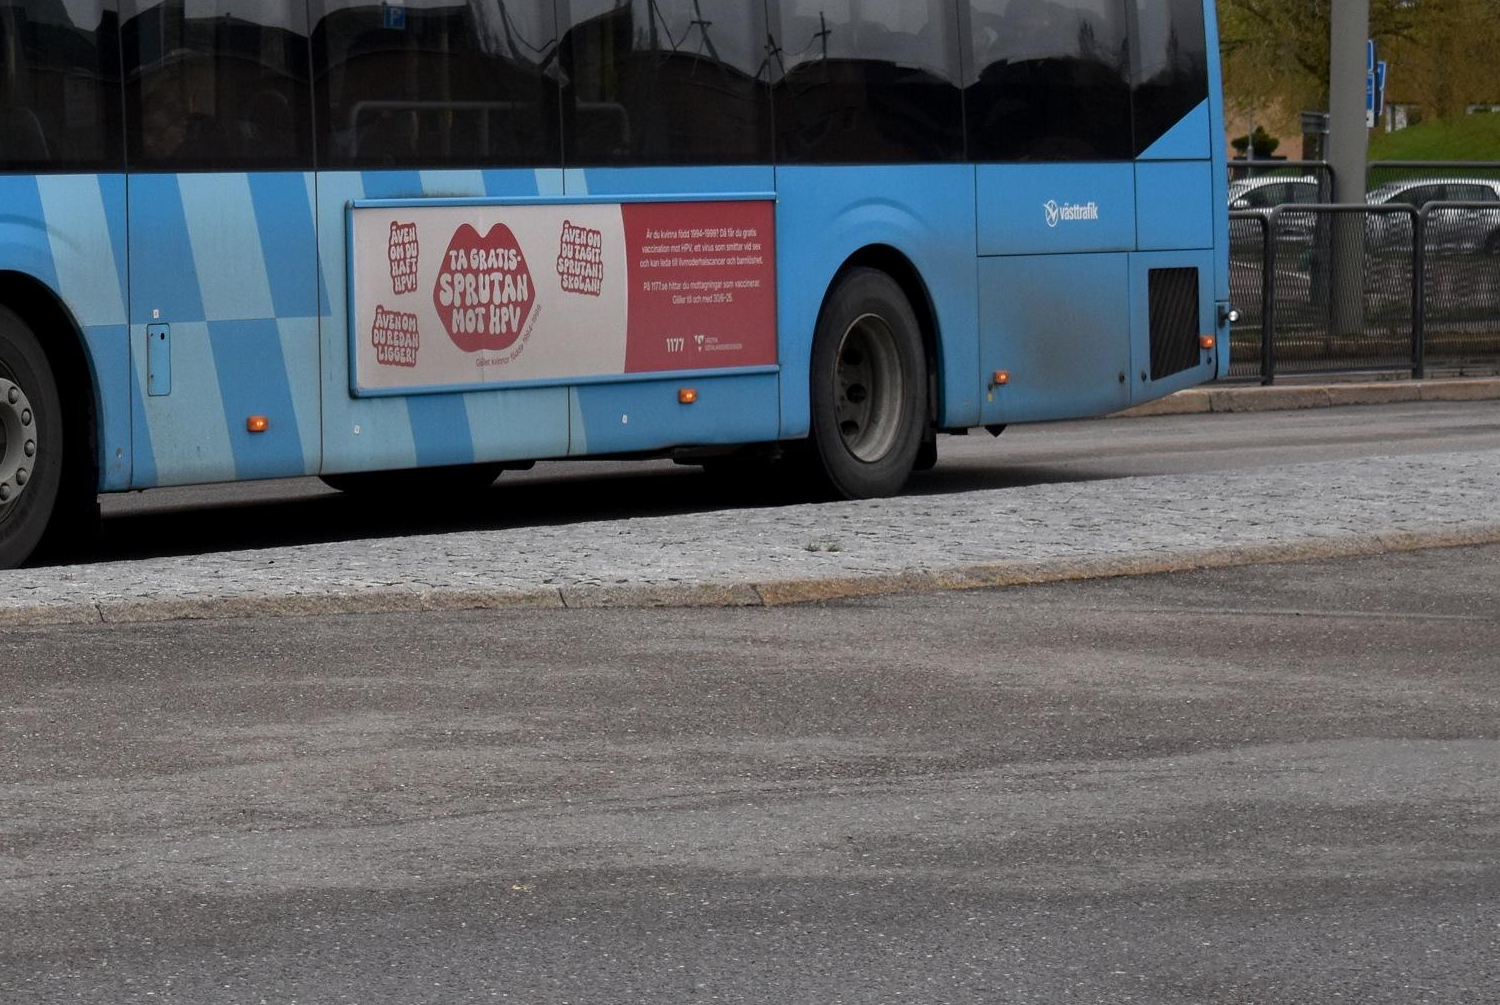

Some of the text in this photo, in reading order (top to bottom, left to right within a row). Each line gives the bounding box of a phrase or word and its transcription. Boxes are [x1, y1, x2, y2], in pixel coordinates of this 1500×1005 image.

[1060, 202, 1098, 220] västtrafik
[391, 226, 416, 245] ÄVEN
[562, 223, 600, 247] ÄVEN OM
[390, 243, 417, 260] OM DU
[449, 249, 468, 271] TA
[562, 243, 600, 263] DU TAGIT
[392, 259, 417, 275] HAFT
[558, 257, 598, 278] SPRUTAN
[394, 274, 416, 292] HPV!
[439, 272, 529, 307] SPRUTAN
[562, 274, 600, 293] SKOLAN!
[376, 308, 417, 331] ÄVEN OM
[452, 304, 520, 334] MOT HPV
[373, 329, 419, 349] DU REDAN
[666, 337, 684, 353] 1177
[378, 346, 416, 364] LIGGER!
